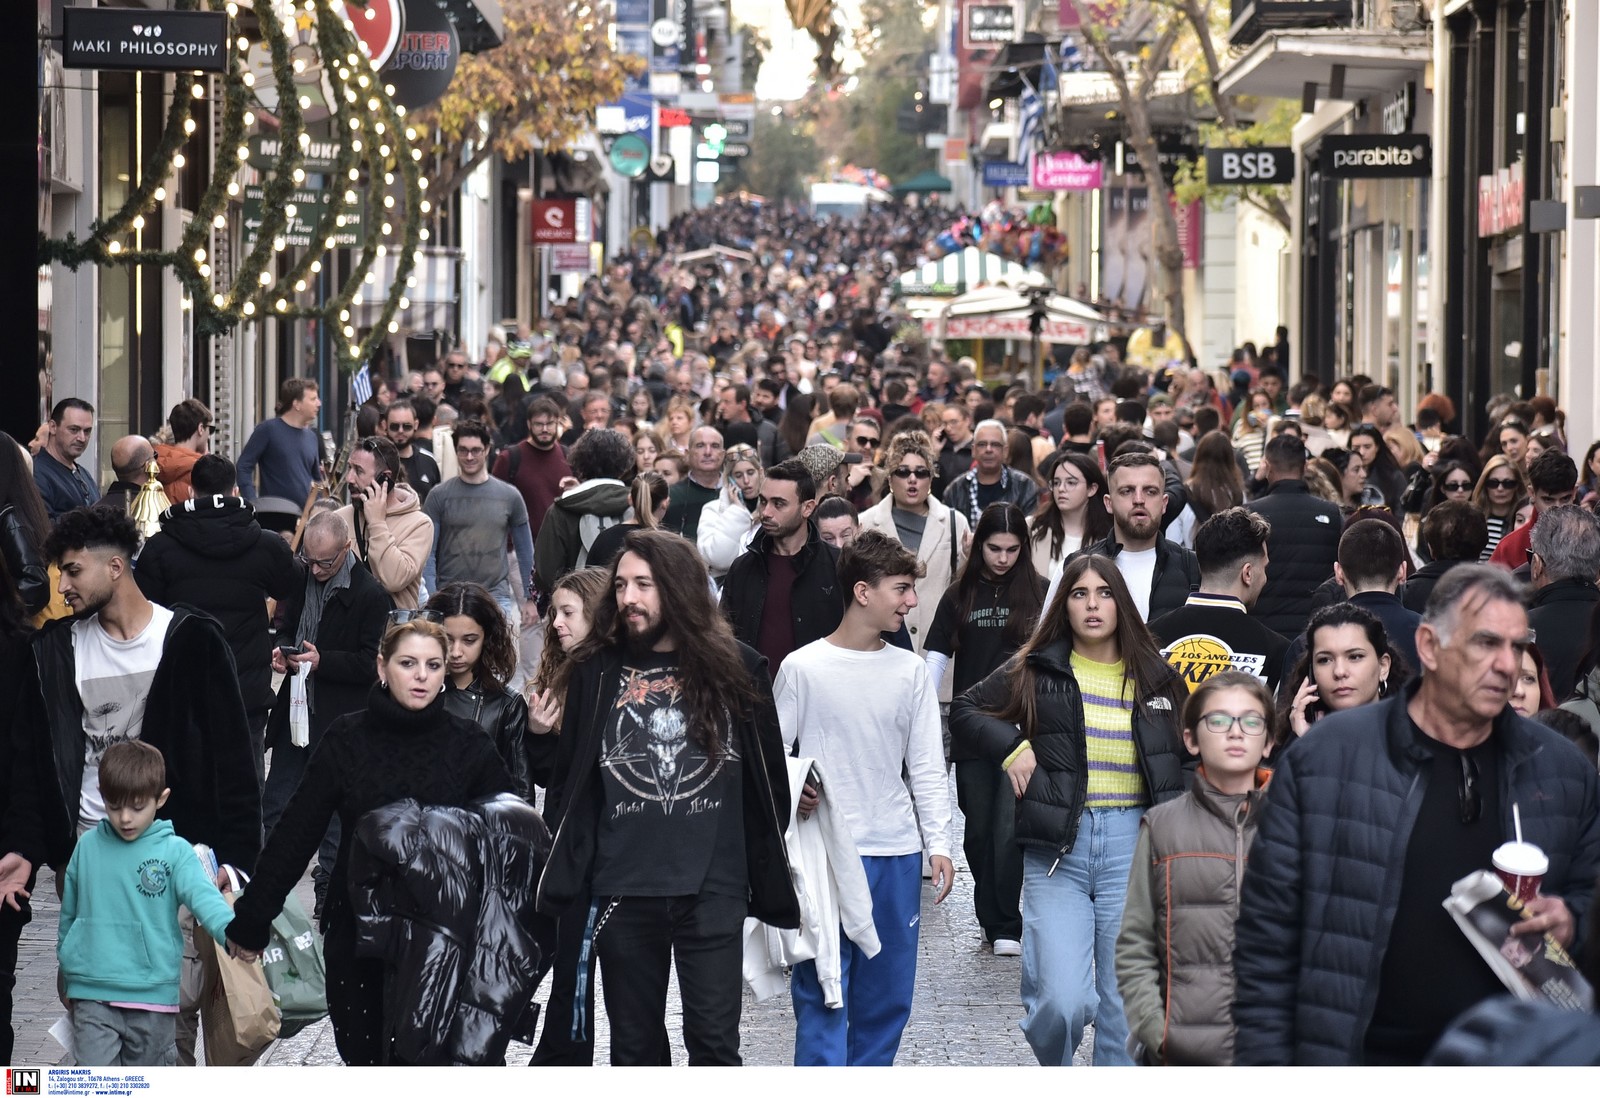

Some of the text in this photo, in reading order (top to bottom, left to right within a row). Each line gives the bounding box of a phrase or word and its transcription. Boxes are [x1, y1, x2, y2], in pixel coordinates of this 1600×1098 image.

[72, 40, 218, 56] MAKI PHILOSOPHY
[1334, 146, 1413, 168] parabita
[1222, 152, 1277, 179] BSB
[1037, 172, 1092, 186] Center
[294, 225, 313, 233] Floor
[1180, 651, 1258, 664] LOS ANGELES
[136, 858, 171, 877] ACTION CLUB
